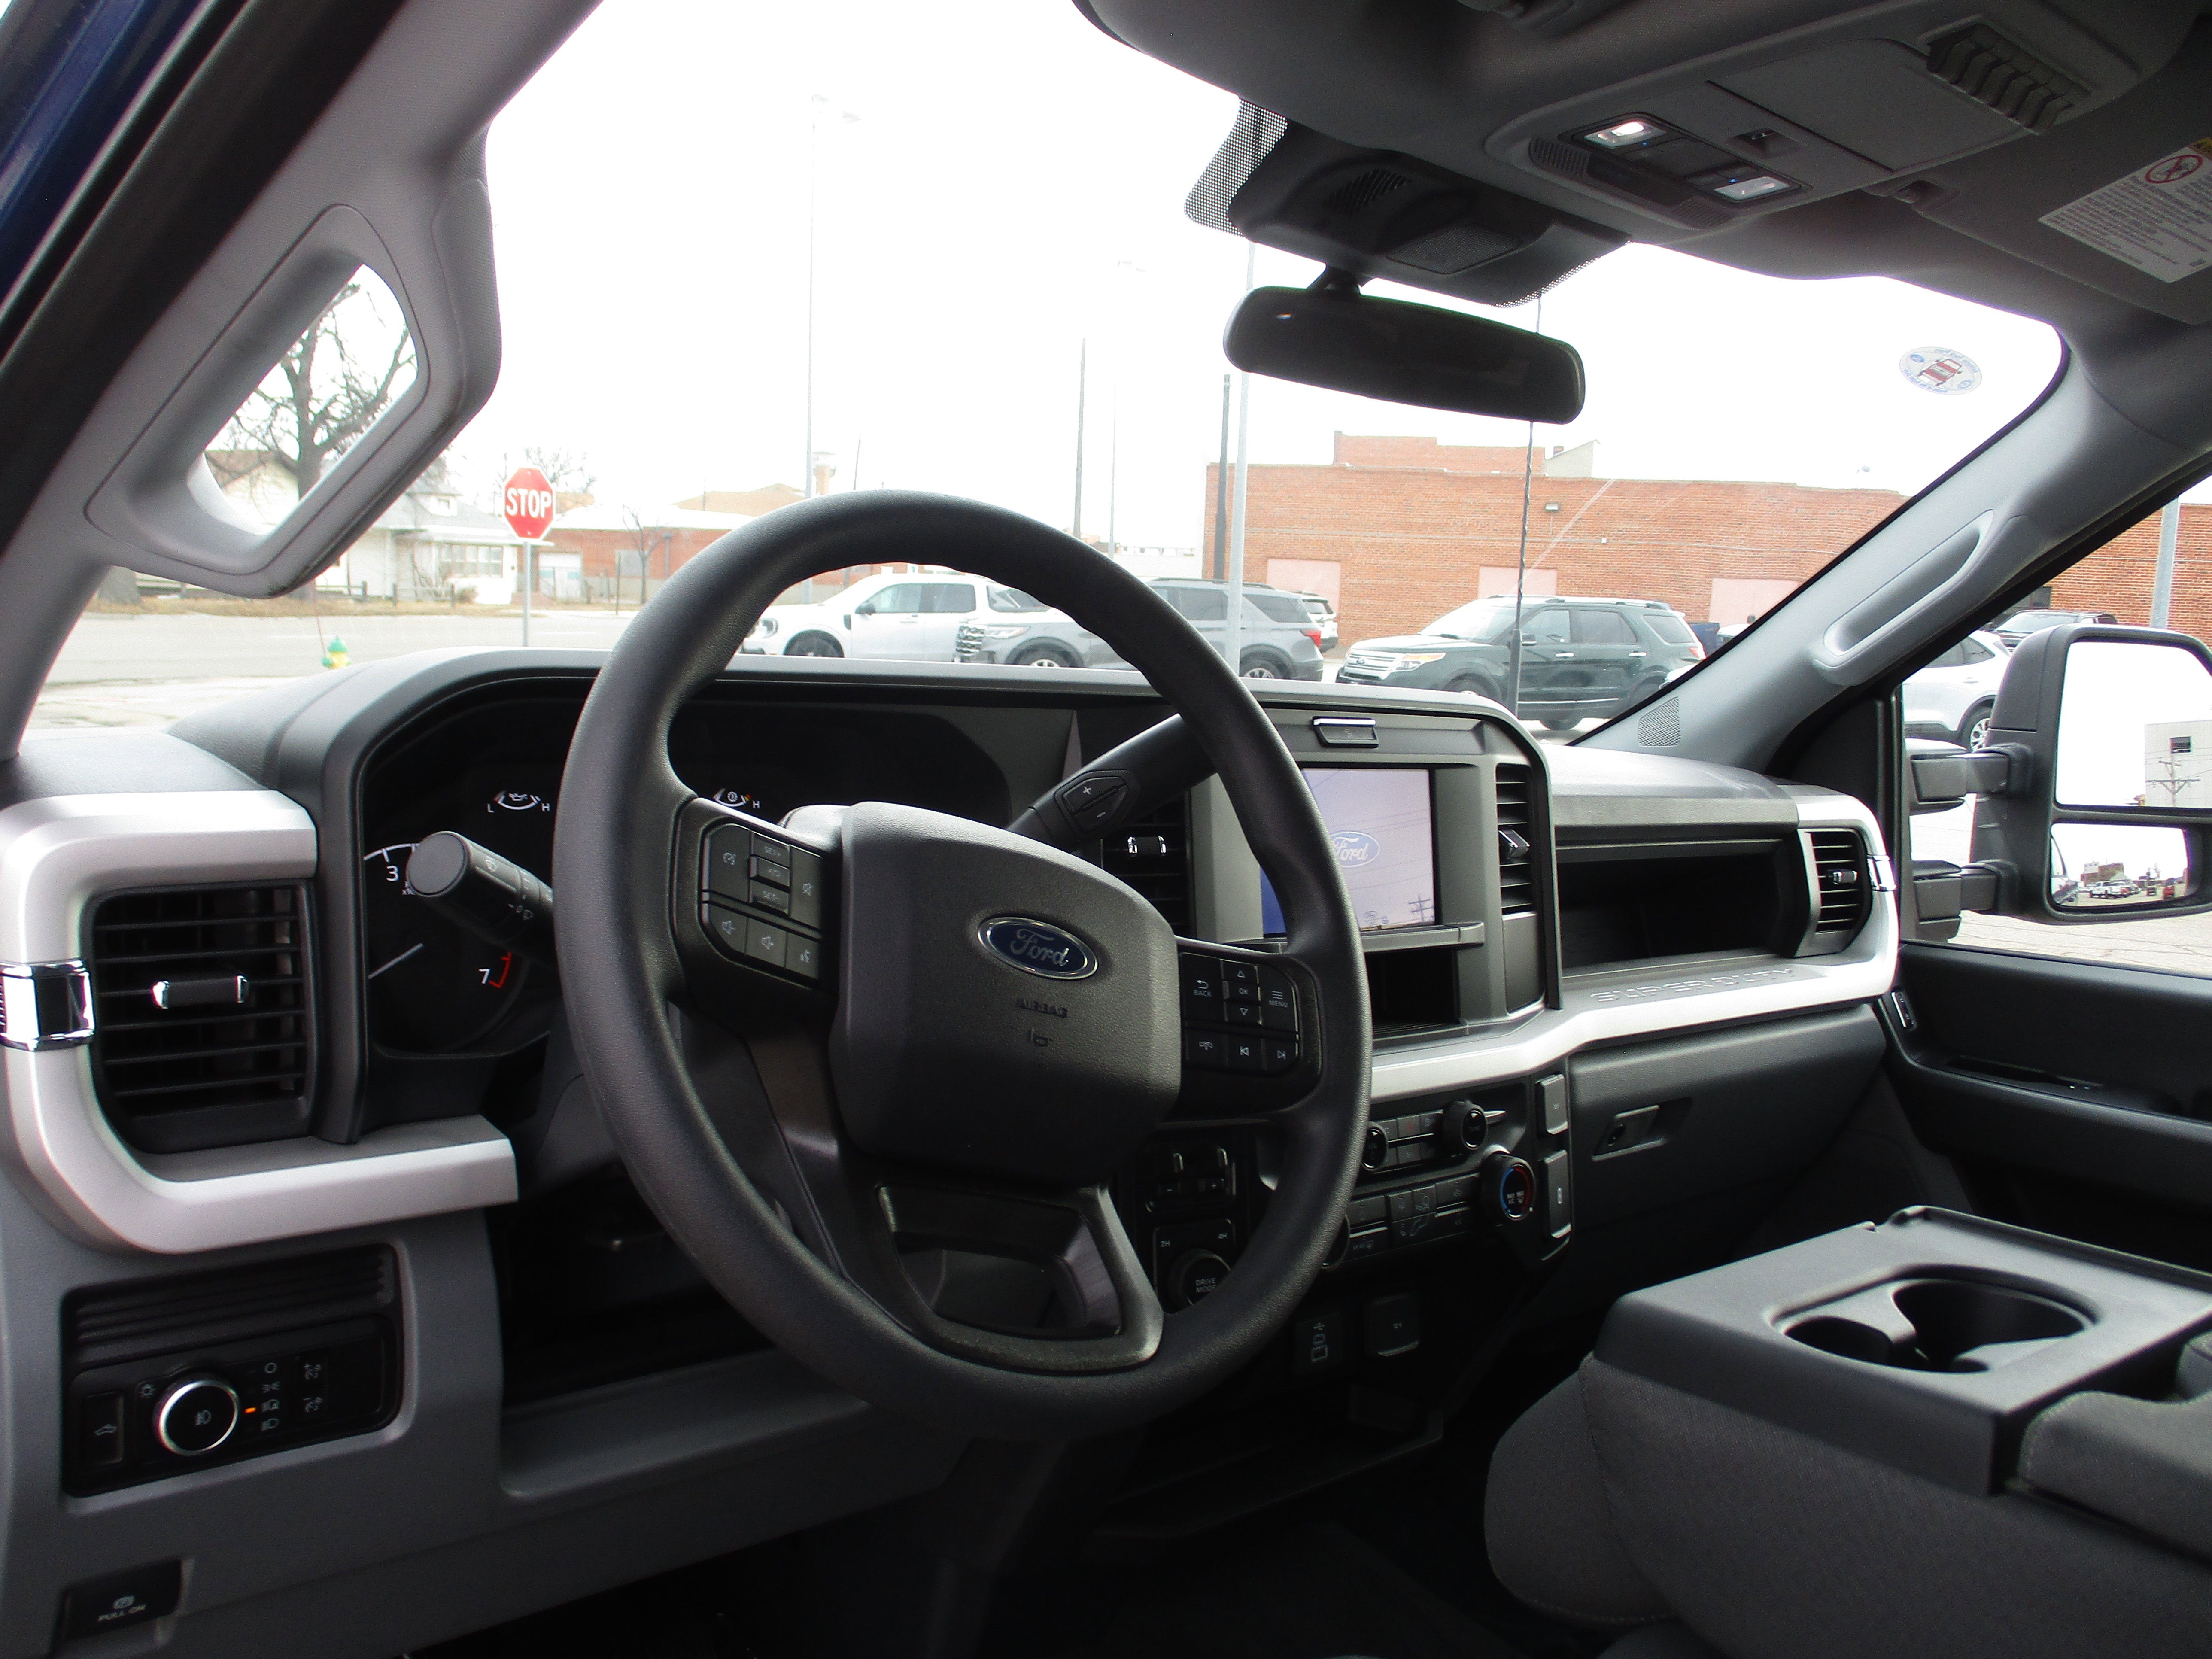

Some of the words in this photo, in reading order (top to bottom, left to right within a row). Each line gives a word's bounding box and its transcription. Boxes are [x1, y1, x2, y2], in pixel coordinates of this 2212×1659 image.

[506, 487, 551, 518] STOP
[487, 804, 494, 813] L
[541, 803, 550, 812] H
[752, 801, 760, 809] H
[1333, 836, 1370, 861] Ford
[386, 865, 398, 882] 3
[1010, 928, 1069, 966] Ford
[479, 969, 490, 984] 7
[1590, 980, 1714, 1002] SUPER
[1711, 969, 1792, 986] DUTY
[1194, 989, 1212, 997] BACK
[1269, 1000, 1288, 1008] MENU
[1196, 1277, 1216, 1286] DRIVE
